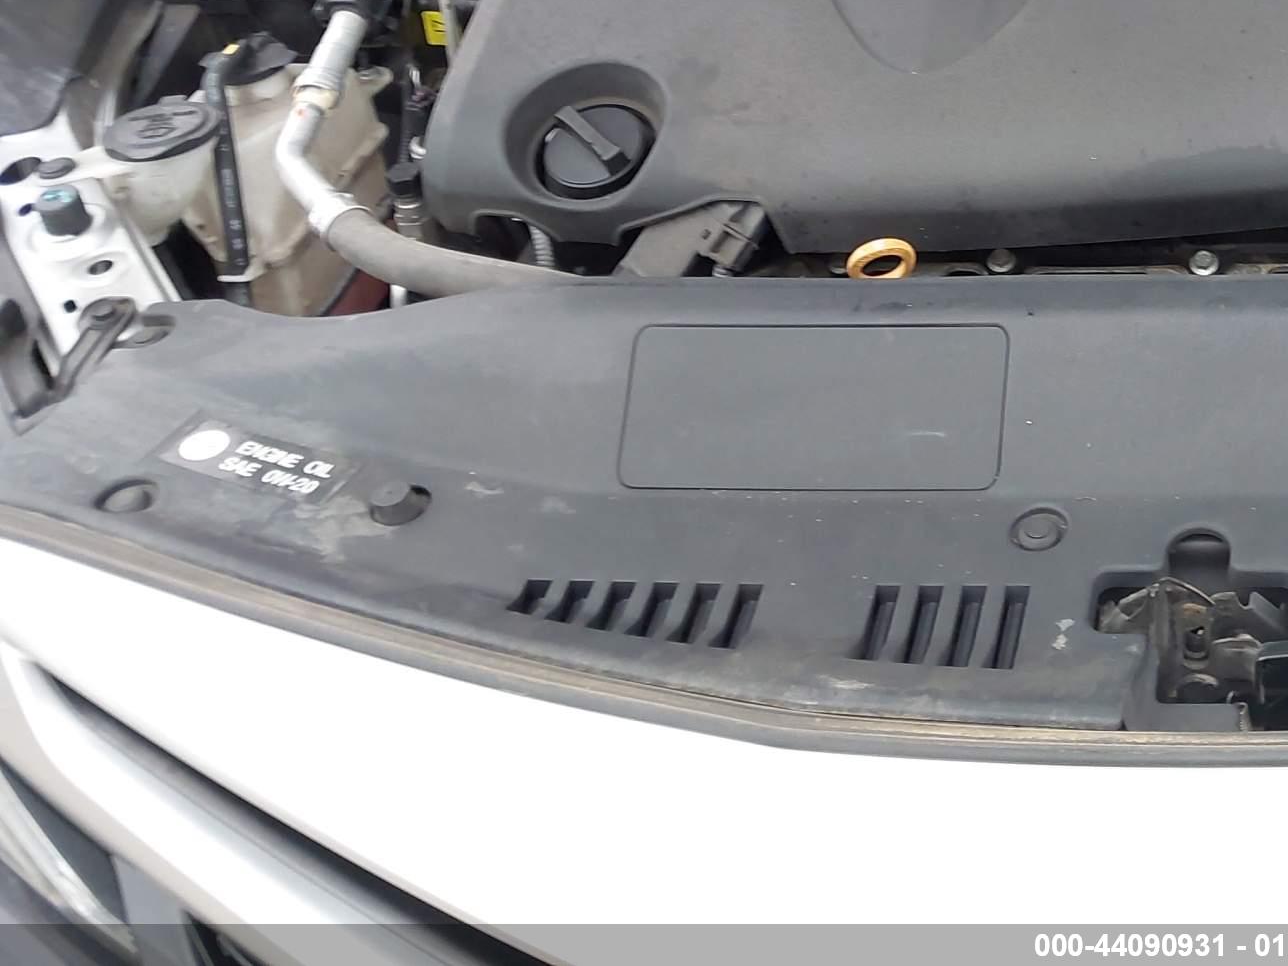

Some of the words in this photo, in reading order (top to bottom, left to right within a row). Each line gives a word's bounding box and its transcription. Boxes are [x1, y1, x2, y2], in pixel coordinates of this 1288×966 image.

[218, 456, 262, 477] SAE
[261, 469, 321, 494] 0W-20
[236, 441, 304, 468] ENGINE
[303, 460, 336, 478] OIL
